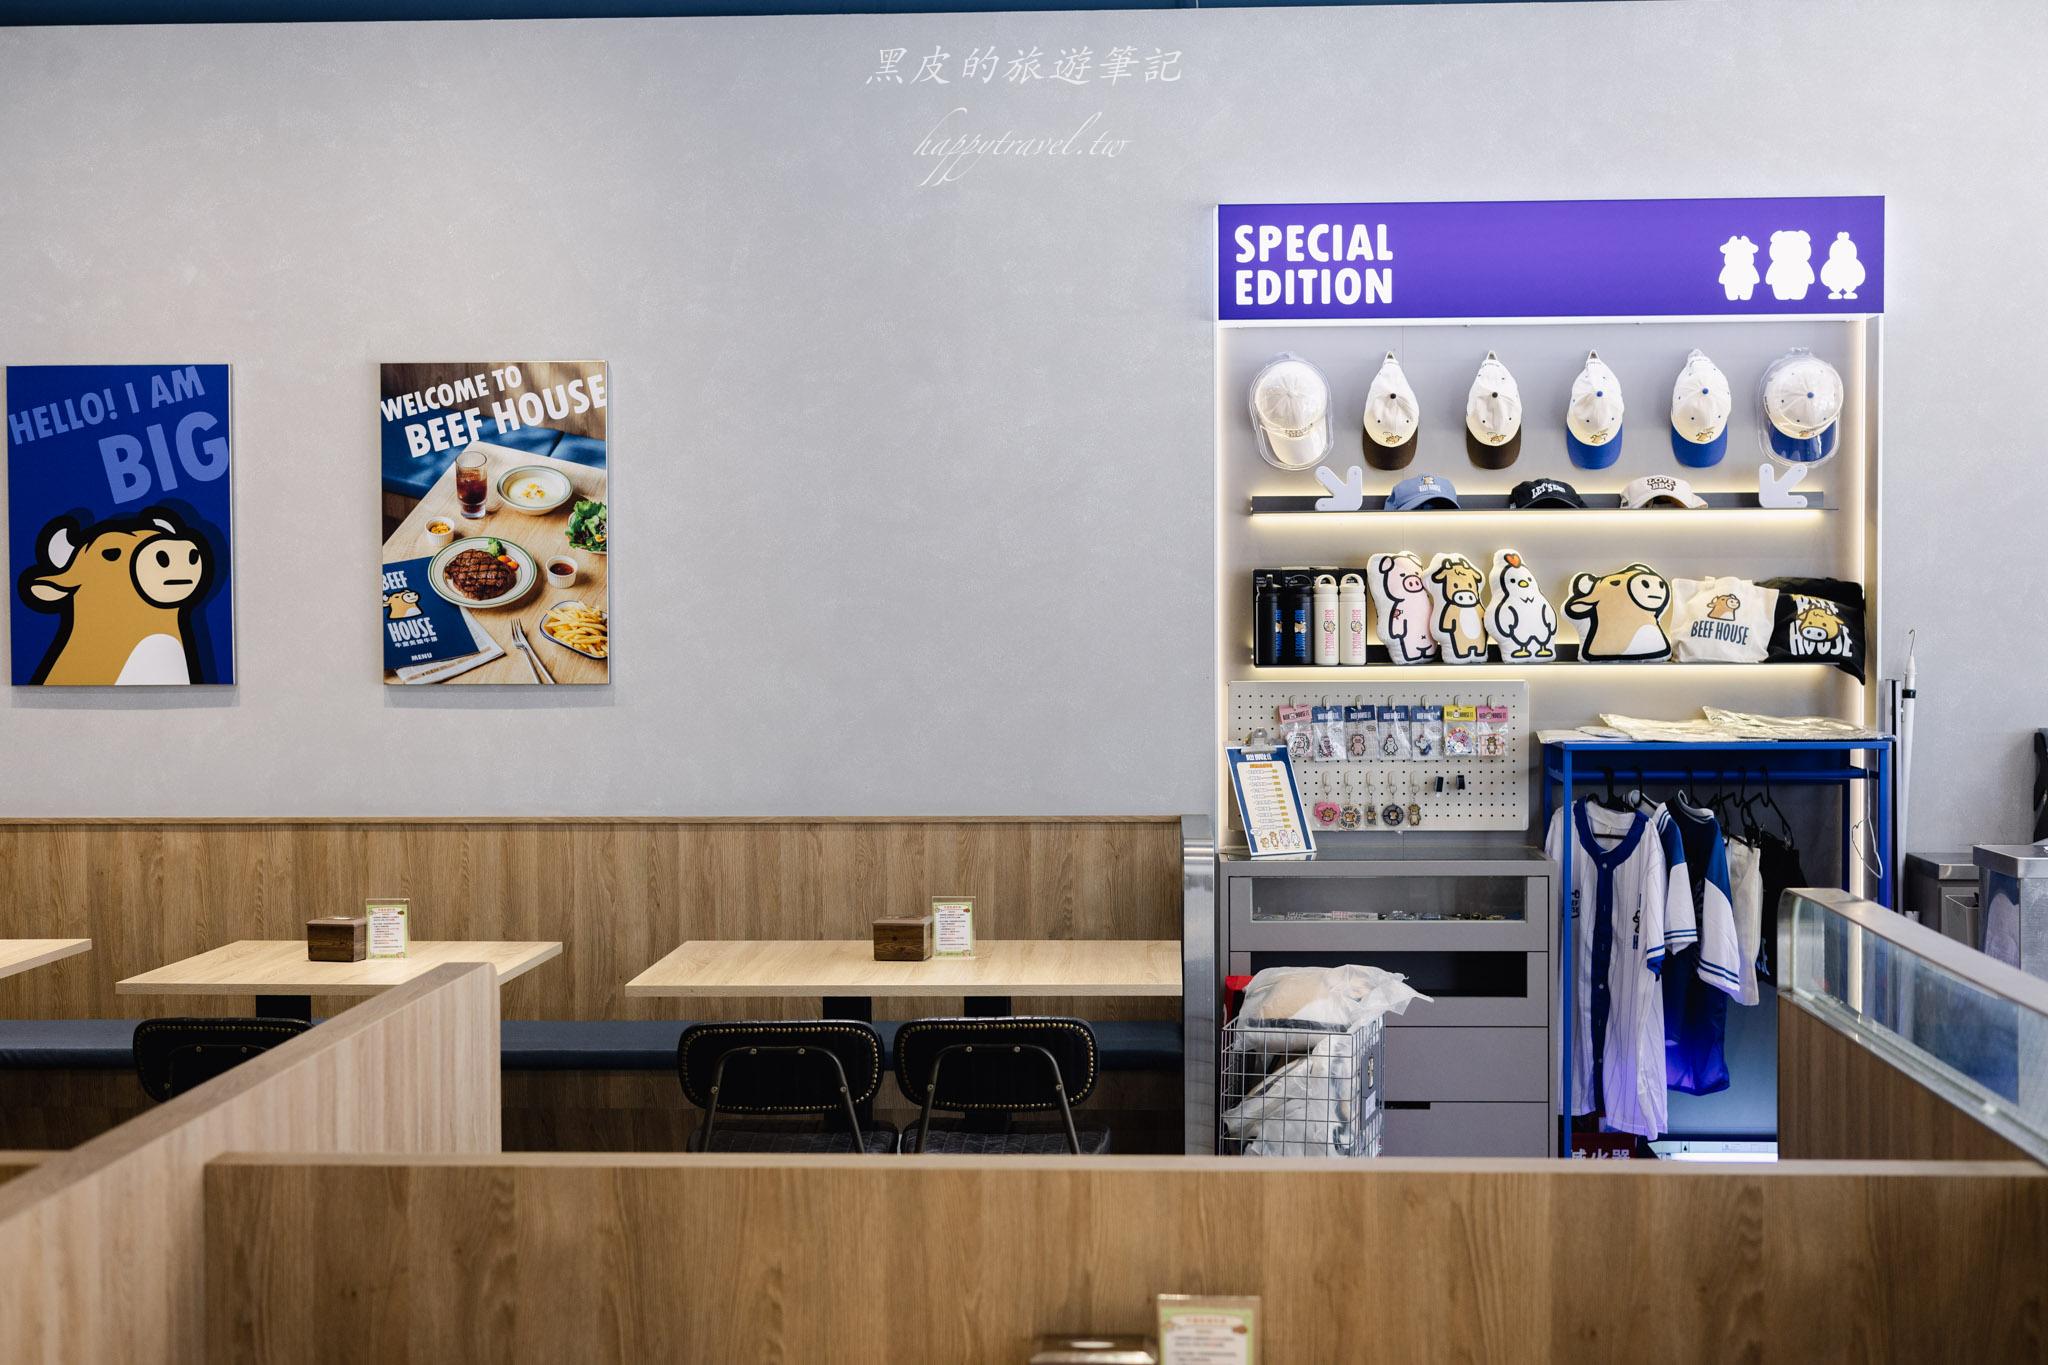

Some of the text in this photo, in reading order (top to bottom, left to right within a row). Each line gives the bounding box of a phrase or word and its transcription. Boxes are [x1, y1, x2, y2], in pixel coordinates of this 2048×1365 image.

[1234, 223, 1394, 263] SPECIAL
[1235, 267, 1393, 306] EDITION
[8, 365, 206, 446] HELLO! I AM
[380, 365, 523, 422] WELCOME TO
[404, 374, 607, 458] BEEF HOUSE
[98, 411, 230, 505] BIG
[1531, 482, 1553, 499] LET'S
[387, 616, 437, 643] HOUSE
[1690, 620, 1750, 646] BEEF HOUSE
